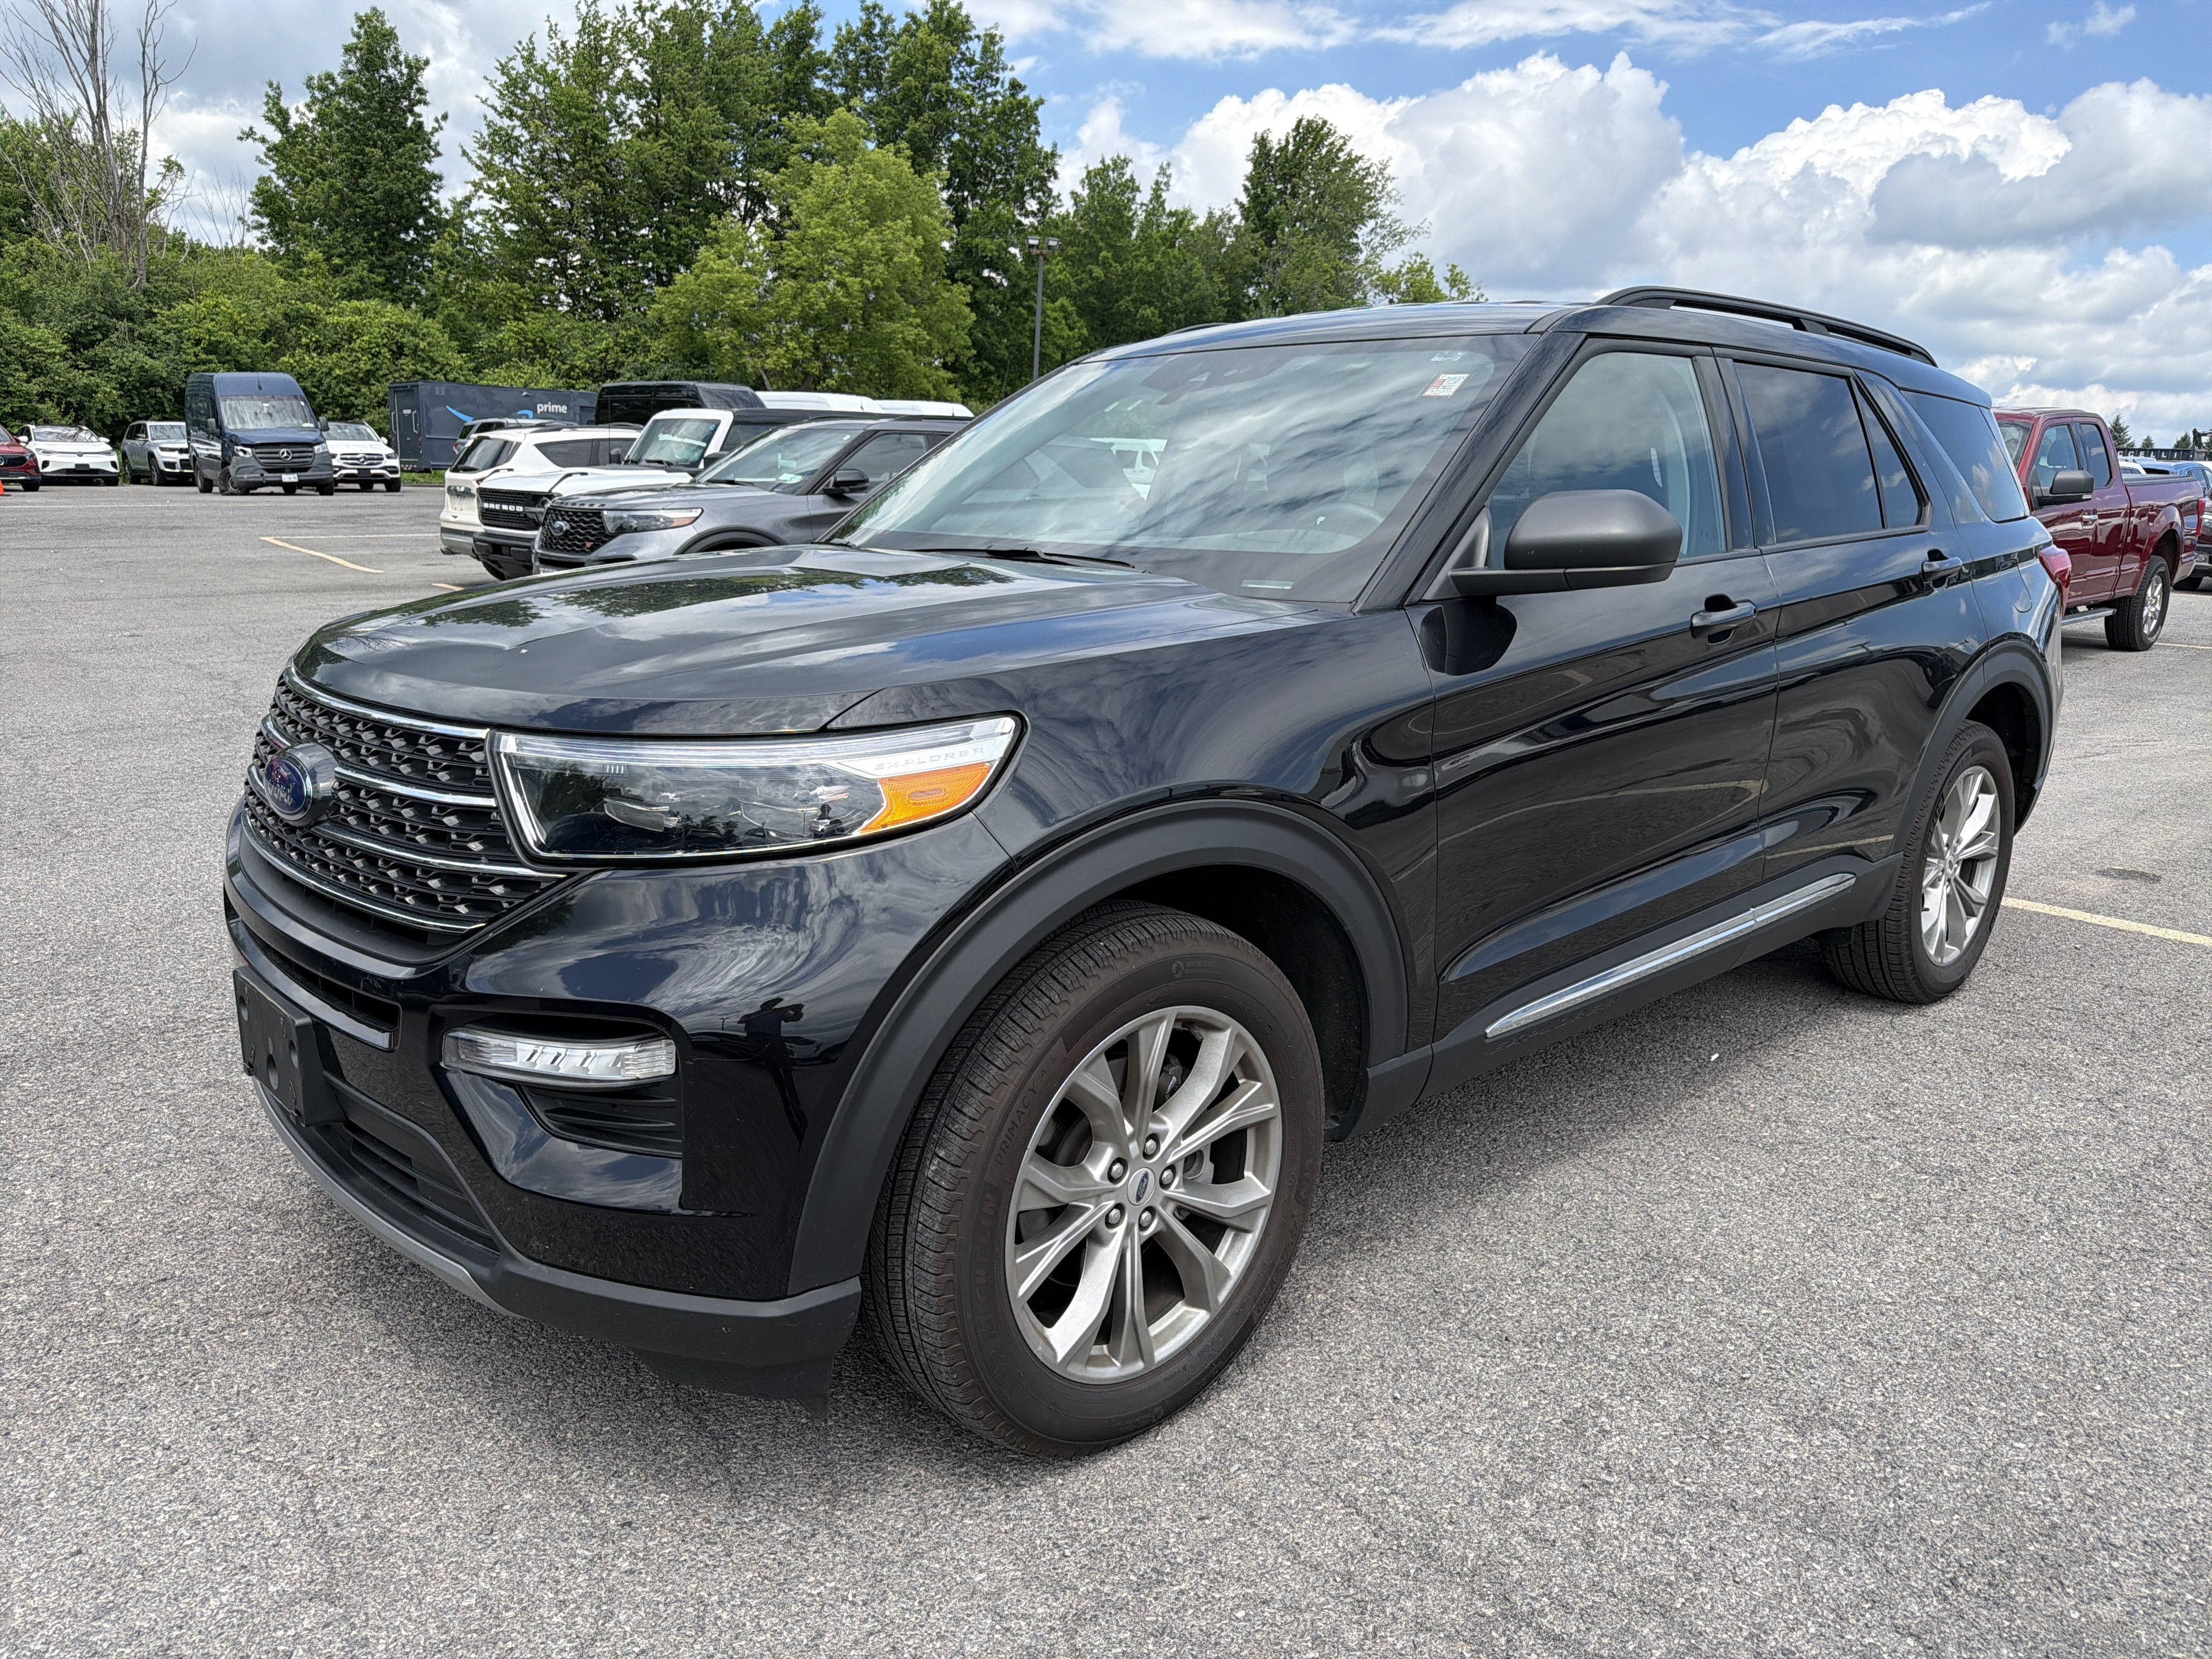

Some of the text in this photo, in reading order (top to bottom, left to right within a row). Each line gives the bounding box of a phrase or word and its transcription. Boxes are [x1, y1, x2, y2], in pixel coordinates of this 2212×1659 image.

[537, 401, 568, 414] prime
[873, 747, 984, 771] EXPLORER
[995, 1081, 1037, 1166] PRIMACY
[1138, 1177, 1148, 1198] Ford
